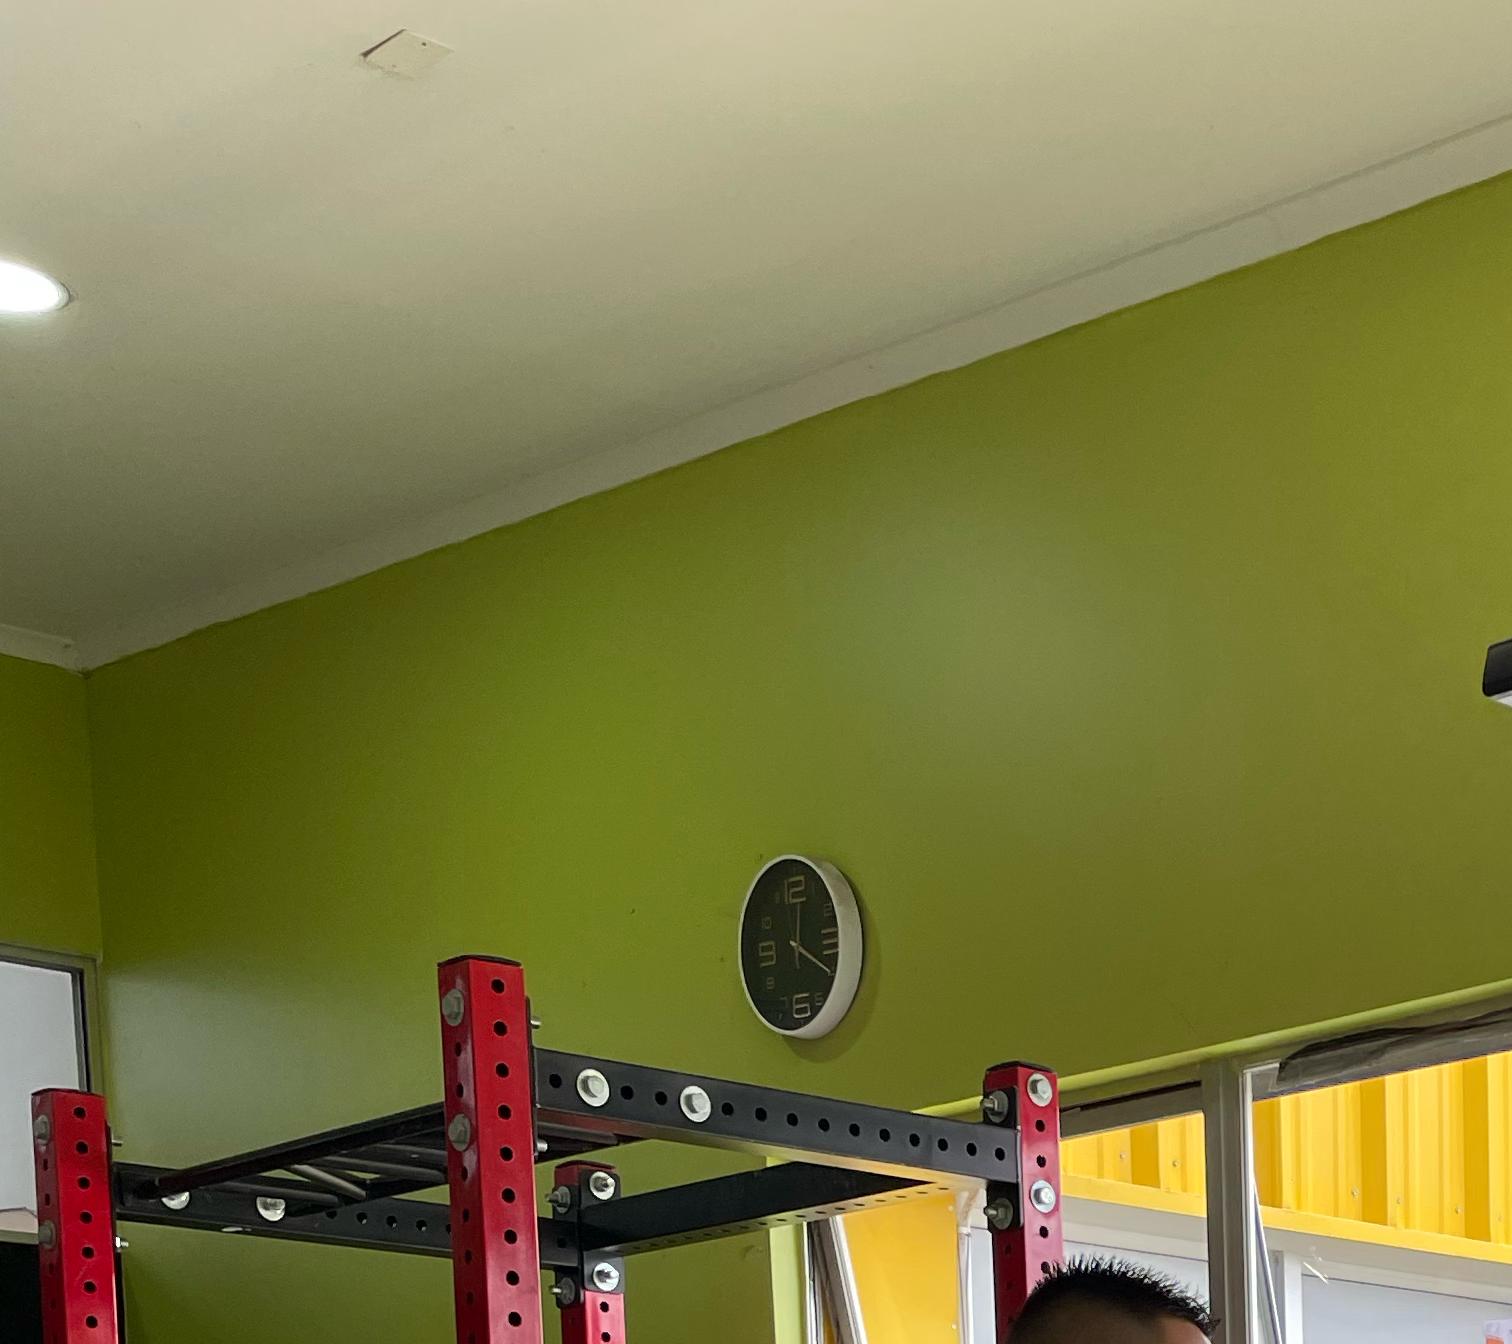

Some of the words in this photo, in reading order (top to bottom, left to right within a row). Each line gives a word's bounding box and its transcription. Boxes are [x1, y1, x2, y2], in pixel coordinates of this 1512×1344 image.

[784, 874, 807, 905] 12
[759, 940, 777, 968] 9
[792, 992, 812, 1019] 6
